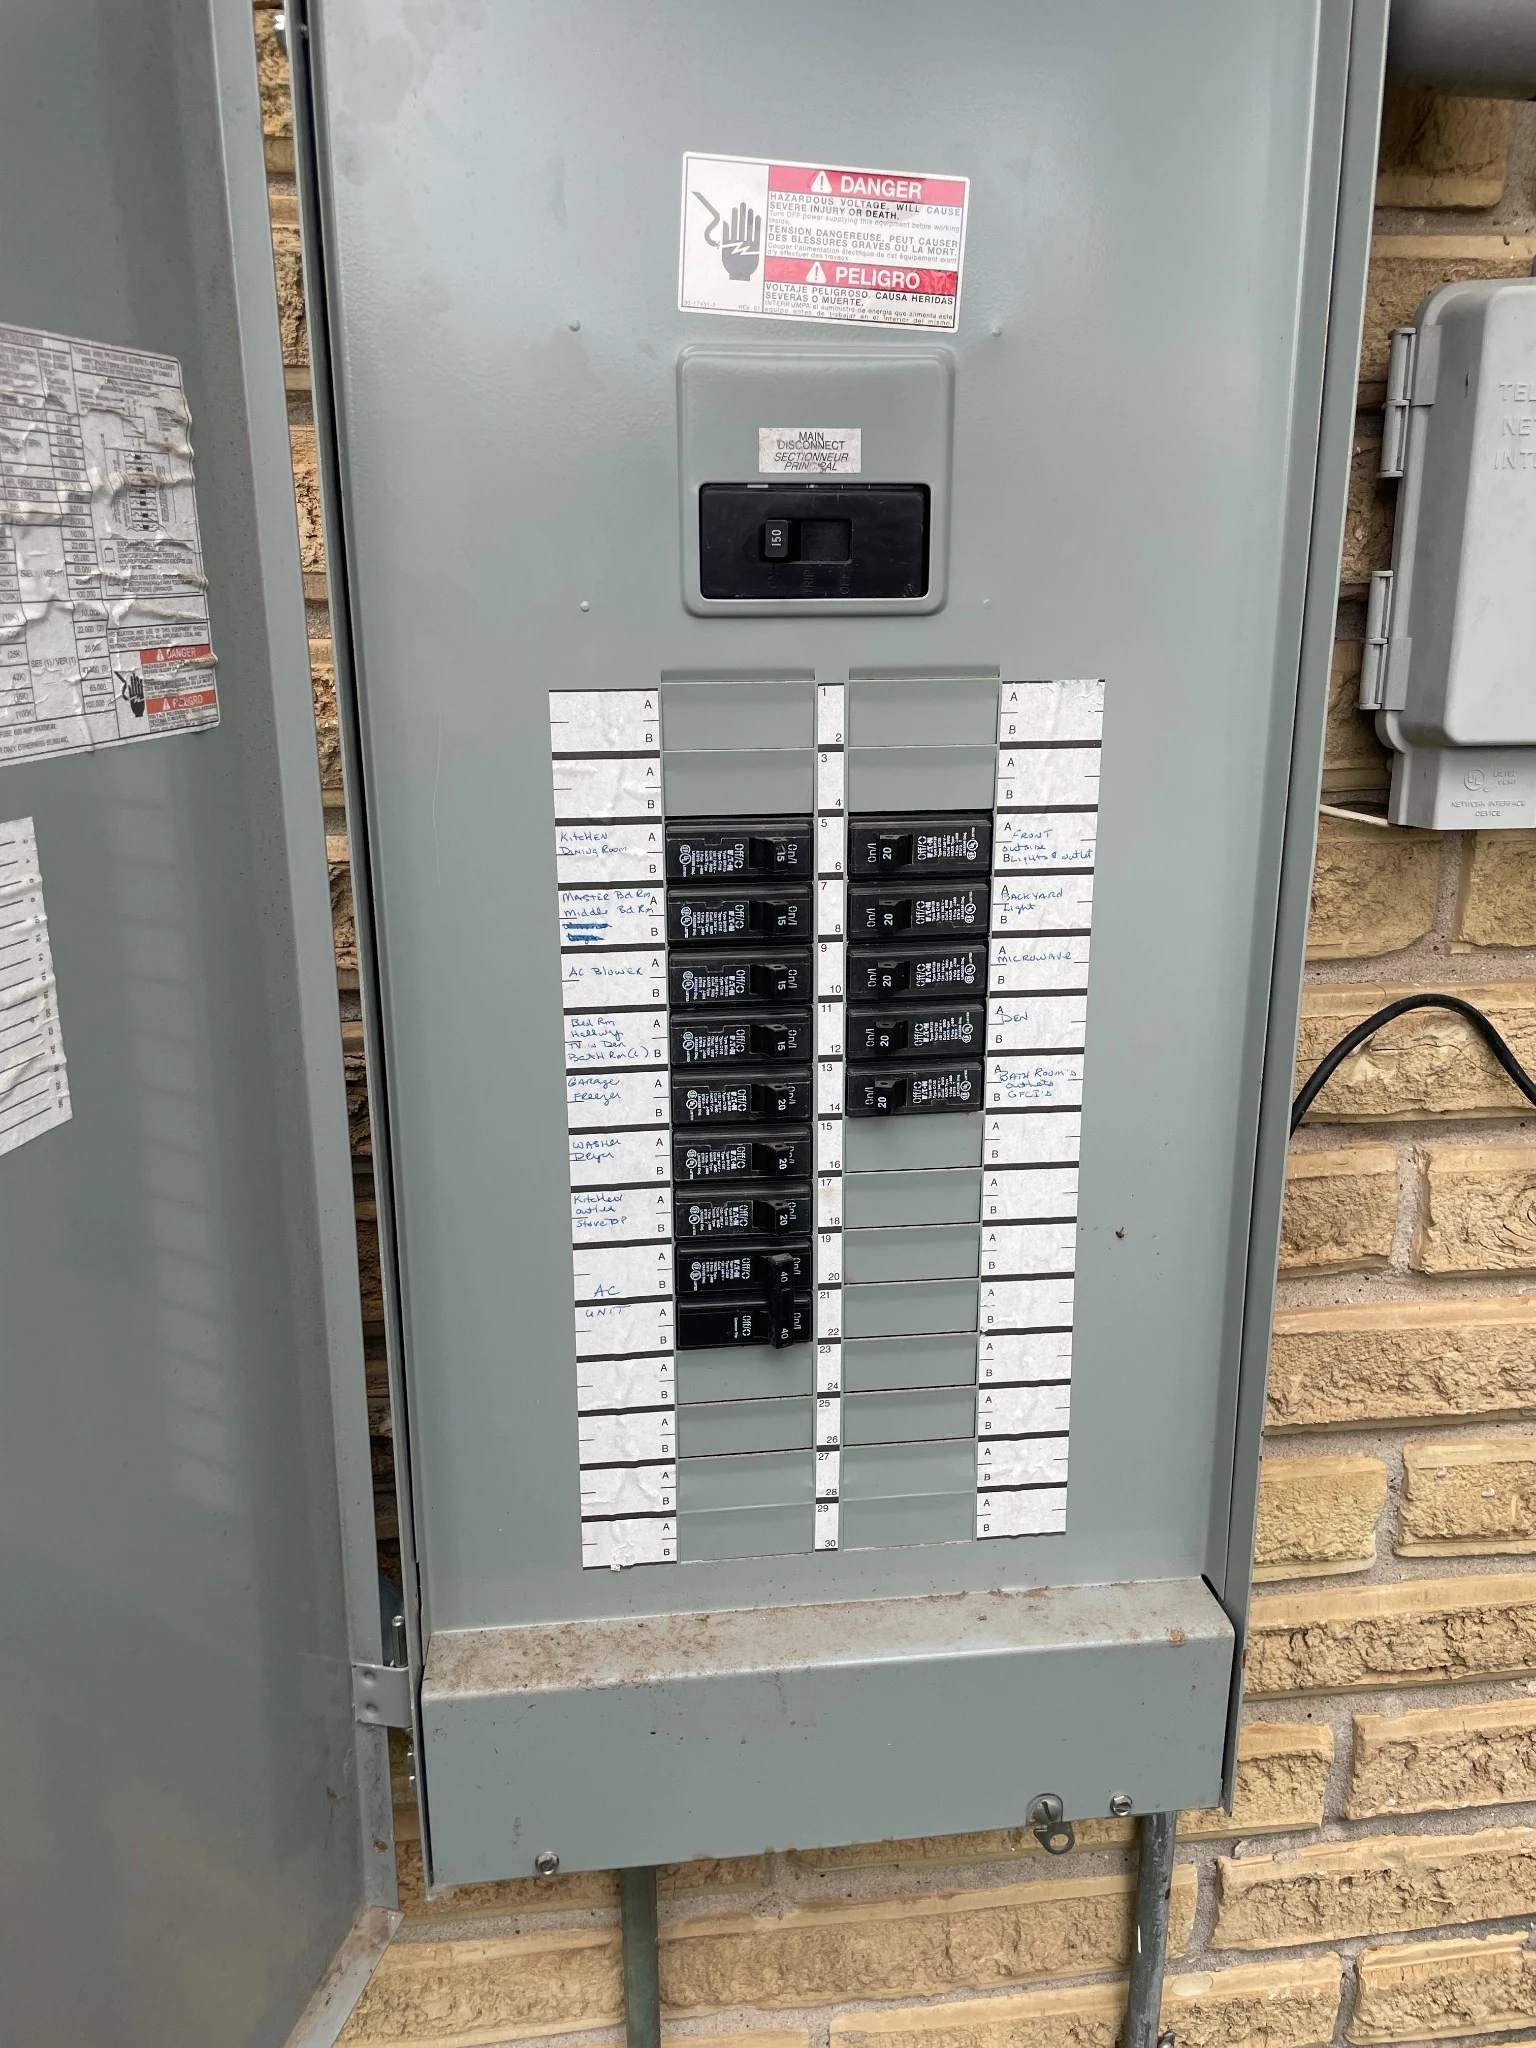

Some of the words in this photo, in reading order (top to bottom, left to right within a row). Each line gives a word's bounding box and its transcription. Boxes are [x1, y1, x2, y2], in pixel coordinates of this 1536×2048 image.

[840, 174, 922, 199] DANGER
[770, 192, 833, 204] HAZARDOUS
[896, 203, 919, 212] WILL
[926, 206, 960, 216] CAUSE
[769, 201, 806, 211] SEVERE
[810, 204, 844, 215] INJURY
[848, 208, 862, 216] OR
[865, 209, 899, 219] DEATH.
[768, 224, 811, 235] TENSION
[889, 235, 914, 244] PEUT
[918, 237, 957, 248] CAUSER
[768, 233, 787, 242] DES
[791, 235, 847, 247] BLESSURES
[851, 240, 890, 250] GRAVES
[894, 244, 907, 252] OU
[912, 245, 923, 253] LA
[835, 265, 920, 289] PELIGRO
[765, 282, 807, 293] VOLTAJE
[875, 291, 907, 301] CAUSA
[911, 294, 953, 305] HERIDAS
[765, 291, 808, 301] SEVERAS
[821, 296, 864, 306] MUERTE.
[799, 432, 824, 442] MAIN
[777, 440, 845, 451] DISCONNECT
[773, 452, 849, 462] SECTIONNEUR
[771, 529, 782, 546] 150
[167, 647, 196, 659] DANGER
[821, 687, 826, 697] 1
[1009, 691, 1018, 702] A
[644, 699, 652, 709] A
[1009, 724, 1016, 734] B
[645, 733, 653, 743] B
[835, 733, 842, 743] 2
[821, 753, 828, 763] 3
[1007, 757, 1015, 767] A
[646, 766, 654, 776] A
[1006, 789, 1013, 799] B
[647, 799, 655, 809] B
[835, 798, 842, 807] 4
[821, 818, 828, 828] 5
[883, 847, 892, 860] 20
[835, 861, 842, 871] 6
[821, 881, 828, 891] 7
[778, 915, 786, 926] 15
[884, 913, 893, 926] 20
[834, 924, 841, 933] 8
[820, 943, 827, 953] 9
[777, 980, 786, 990] 15
[883, 975, 891, 987] 20
[830, 984, 842, 994] 10
[821, 1004, 832, 1013] 11
[880, 1035, 889, 1046] 20
[777, 1041, 785, 1051] 15
[830, 1044, 842, 1053] 12
[821, 1063, 833, 1072] 13
[778, 1099, 786, 1111] 20
[829, 1103, 841, 1112] 14
[878, 1097, 886, 1109] 20
[821, 1122, 833, 1131] 15
[779, 1158, 787, 1169] 20
[829, 1160, 841, 1169] 16
[820, 1178, 832, 1187] 17
[779, 1214, 788, 1226] 20
[828, 1216, 841, 1225] 18
[820, 1234, 831, 1243] 19
[781, 1271, 788, 1283] 40
[828, 1272, 840, 1281] 20
[819, 1291, 830, 1299] 21
[781, 1328, 789, 1340] 40
[827, 1327, 840, 1336] 22
[819, 1345, 832, 1354] 23
[827, 1382, 839, 1390] 24
[818, 1399, 831, 1408] 25
[826, 1435, 839, 1444] 26
[817, 1452, 829, 1461] 27
[825, 1488, 838, 1496] 28
[817, 1504, 829, 1513] 29
[824, 1539, 837, 1547] 30
